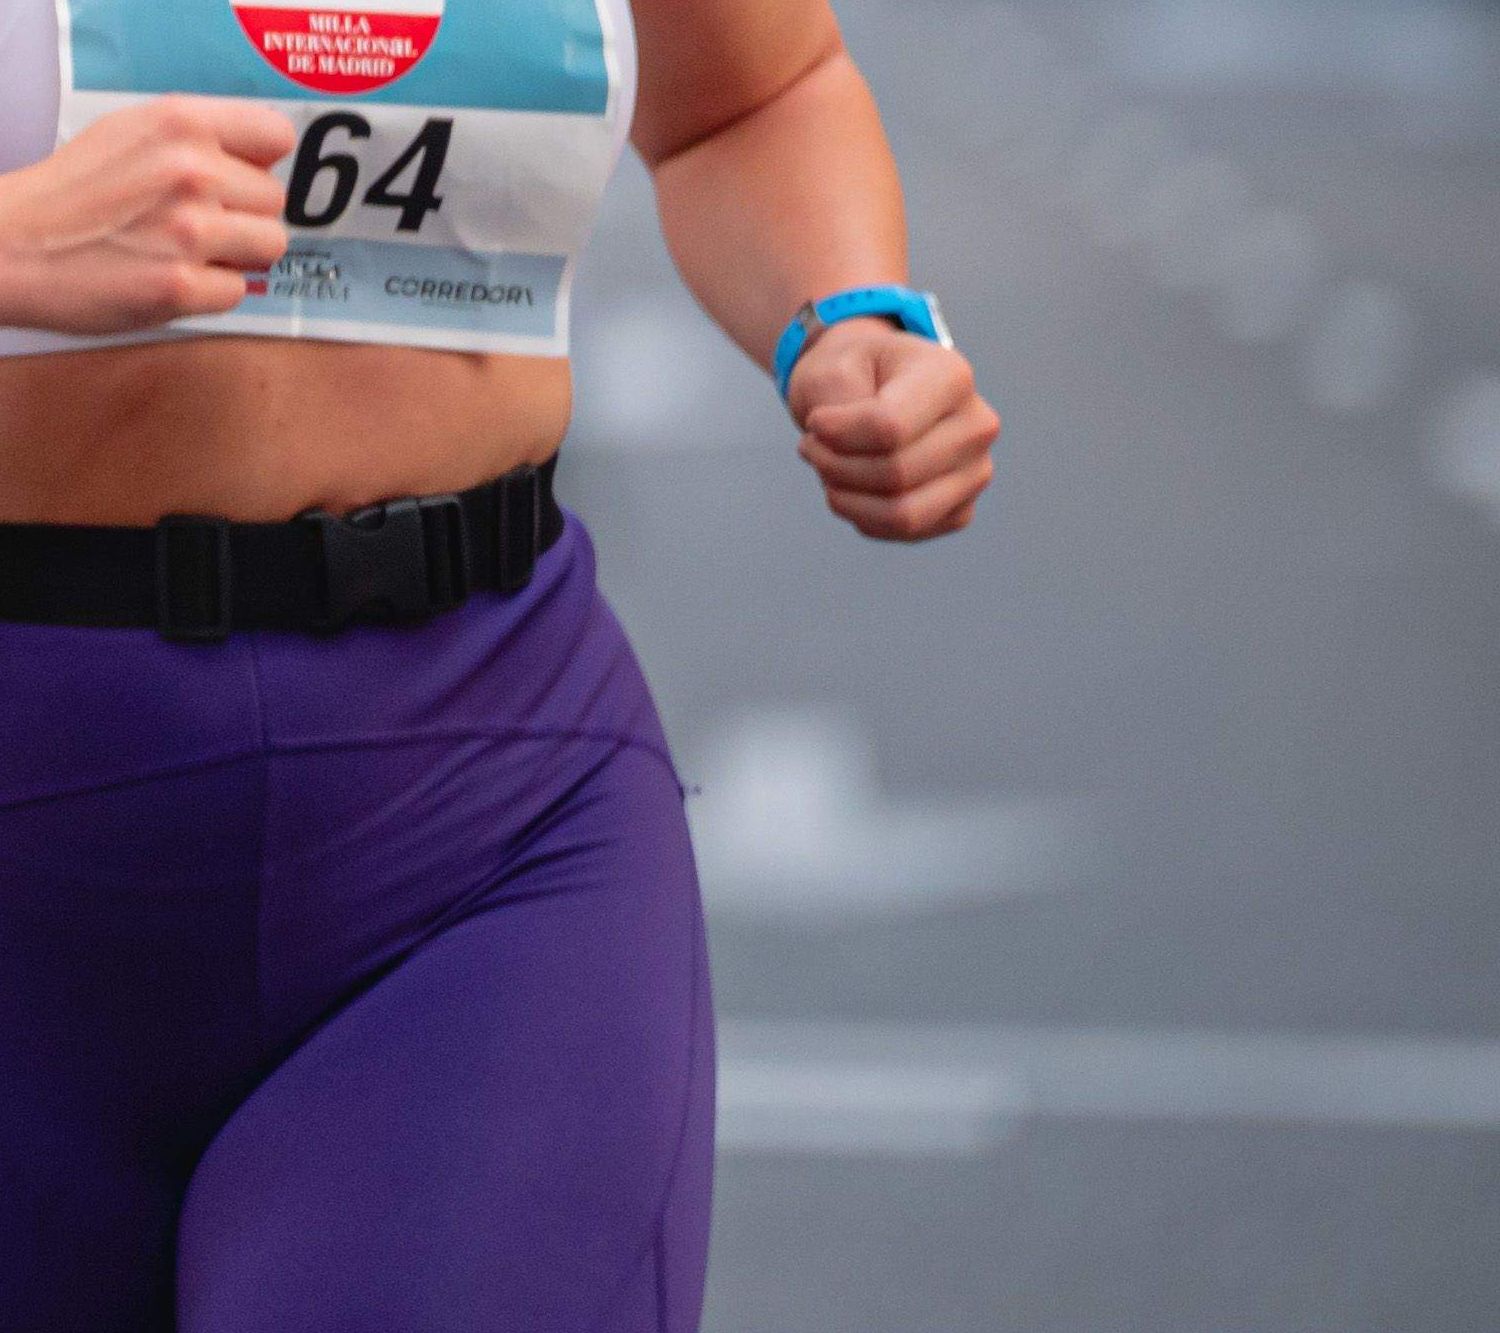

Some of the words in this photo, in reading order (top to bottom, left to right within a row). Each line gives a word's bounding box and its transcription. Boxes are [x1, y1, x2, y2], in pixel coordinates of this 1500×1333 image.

[308, 13, 372, 34] MILLA
[288, 54, 315, 74] DE
[318, 55, 396, 77] MADRID
[283, 110, 454, 232] 64
